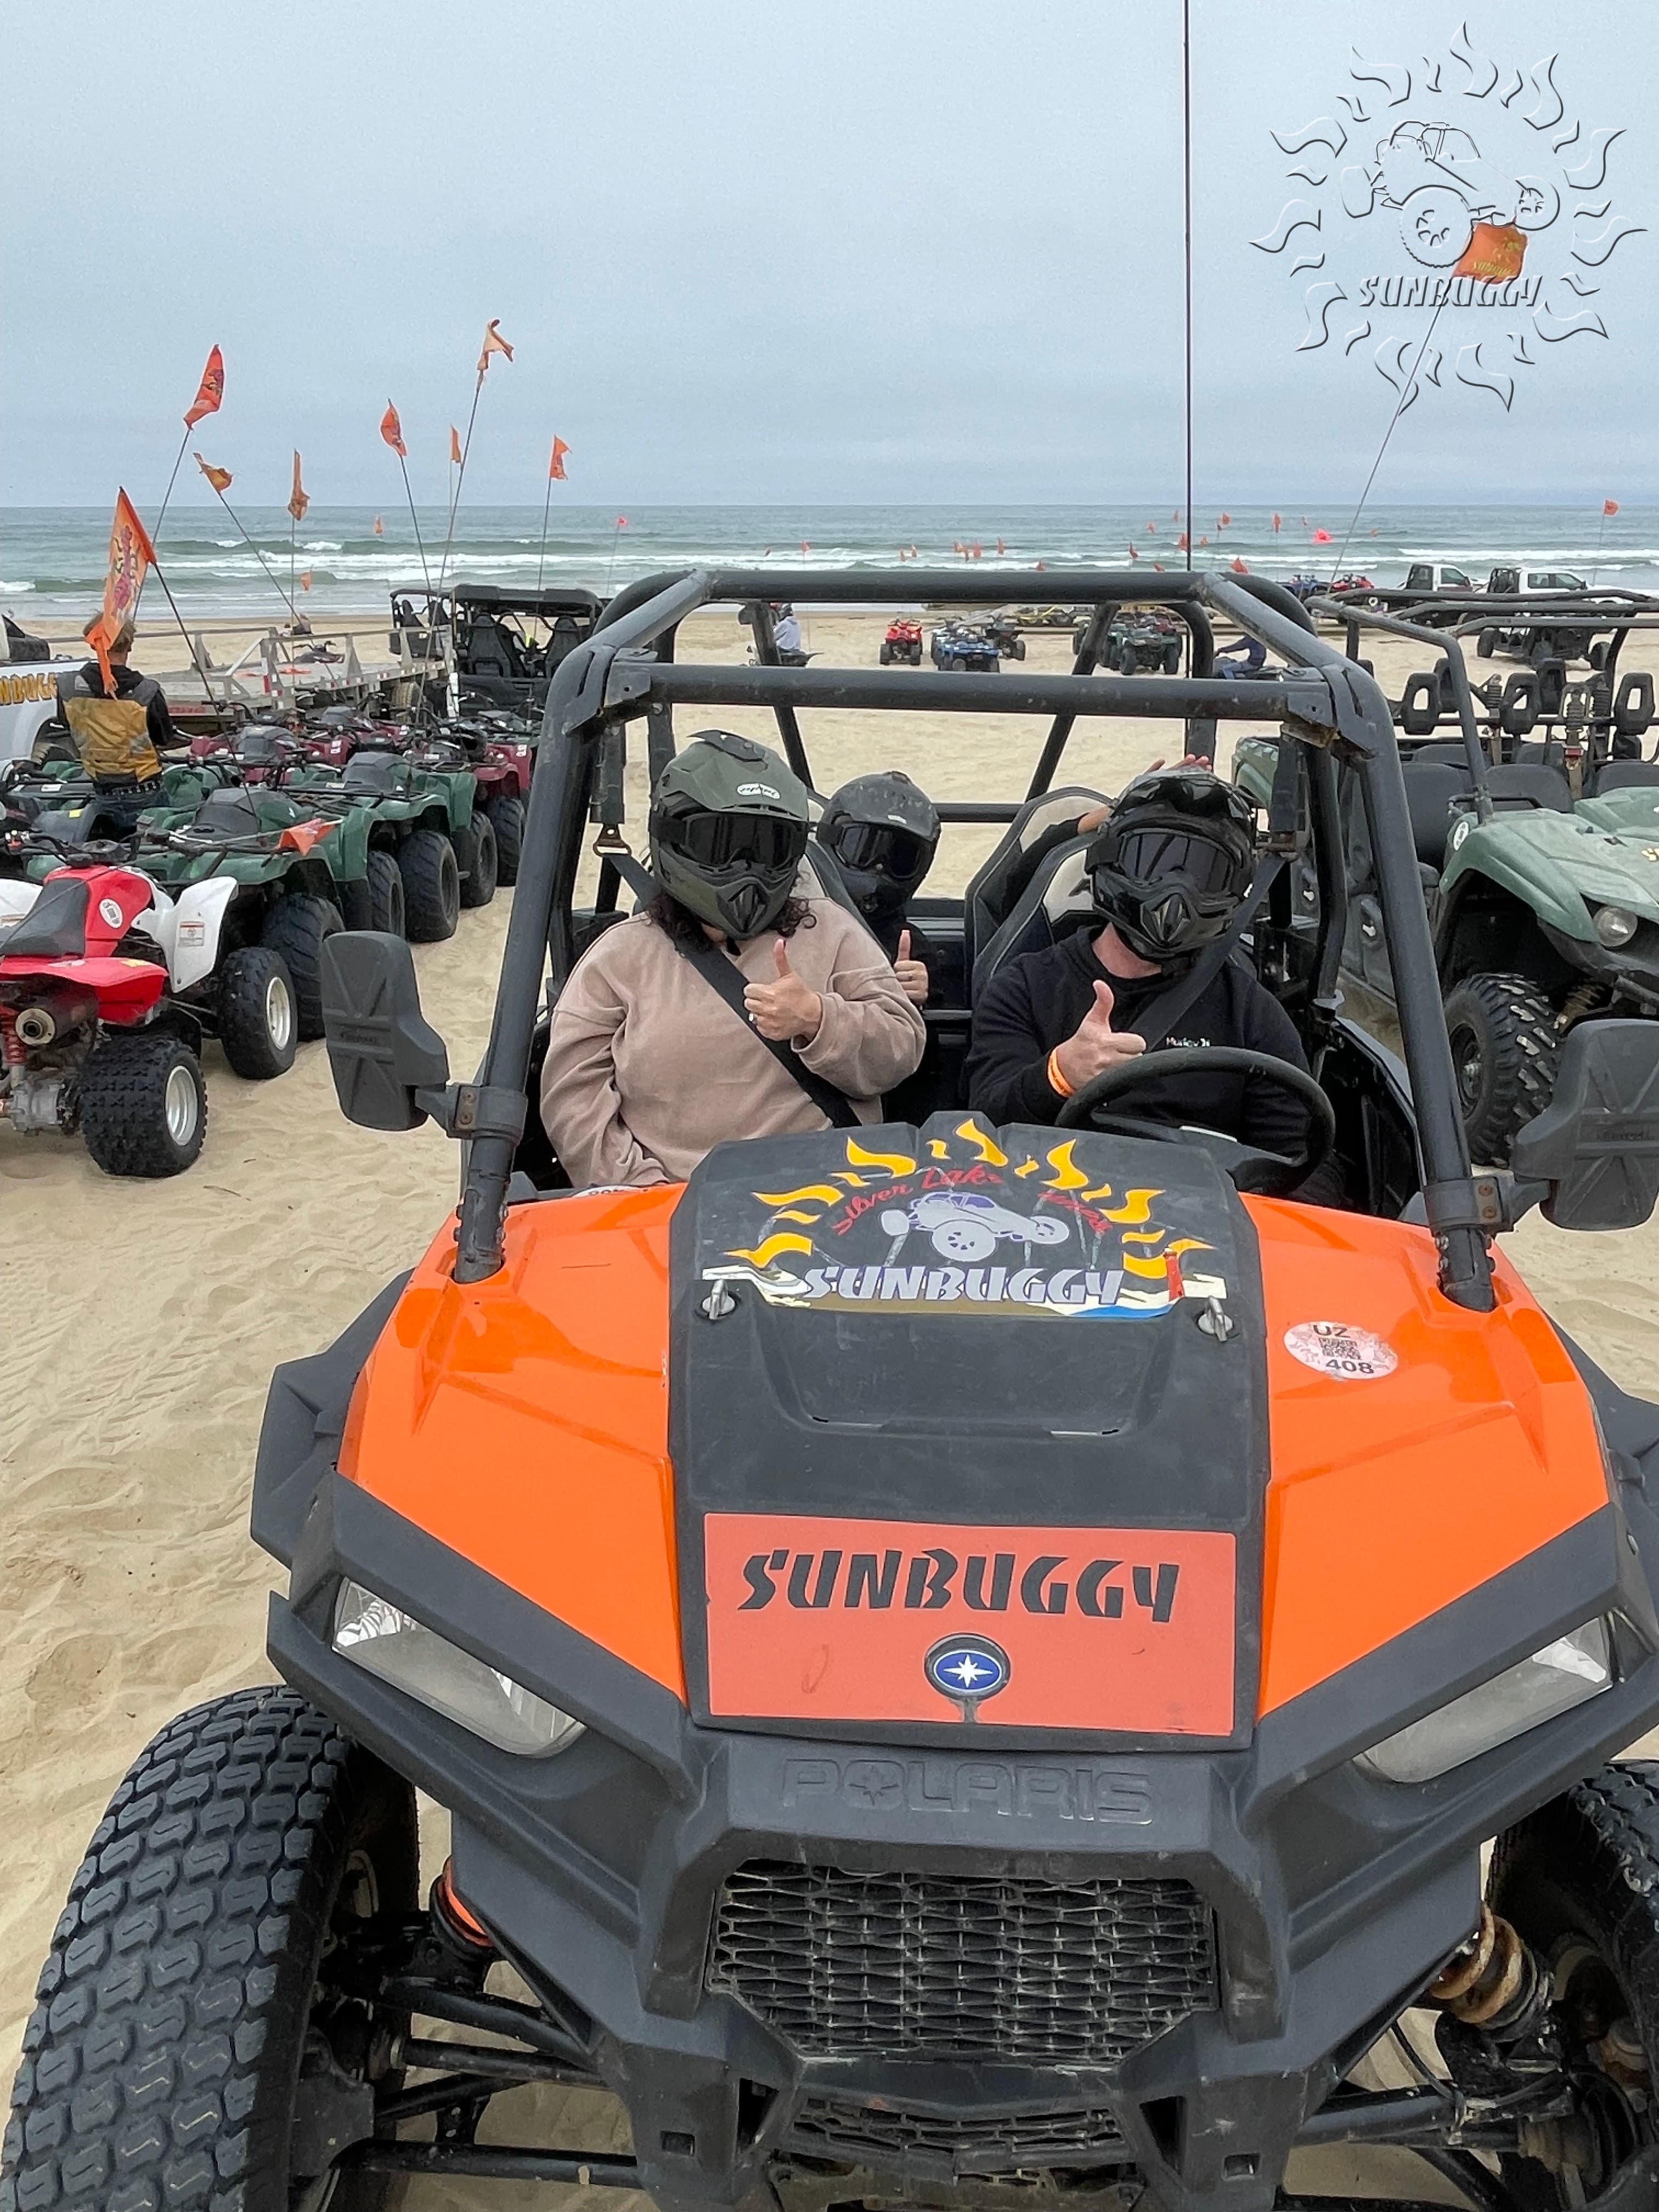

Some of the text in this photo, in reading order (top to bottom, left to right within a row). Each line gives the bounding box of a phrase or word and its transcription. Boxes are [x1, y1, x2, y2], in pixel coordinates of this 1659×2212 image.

[802, 1266, 1125, 1305] SUNBUGGY
[1325, 1359, 1375, 1374] 408
[738, 1547, 1180, 1623] SUNBUGGY
[782, 1757, 1153, 1825] POLARIS
